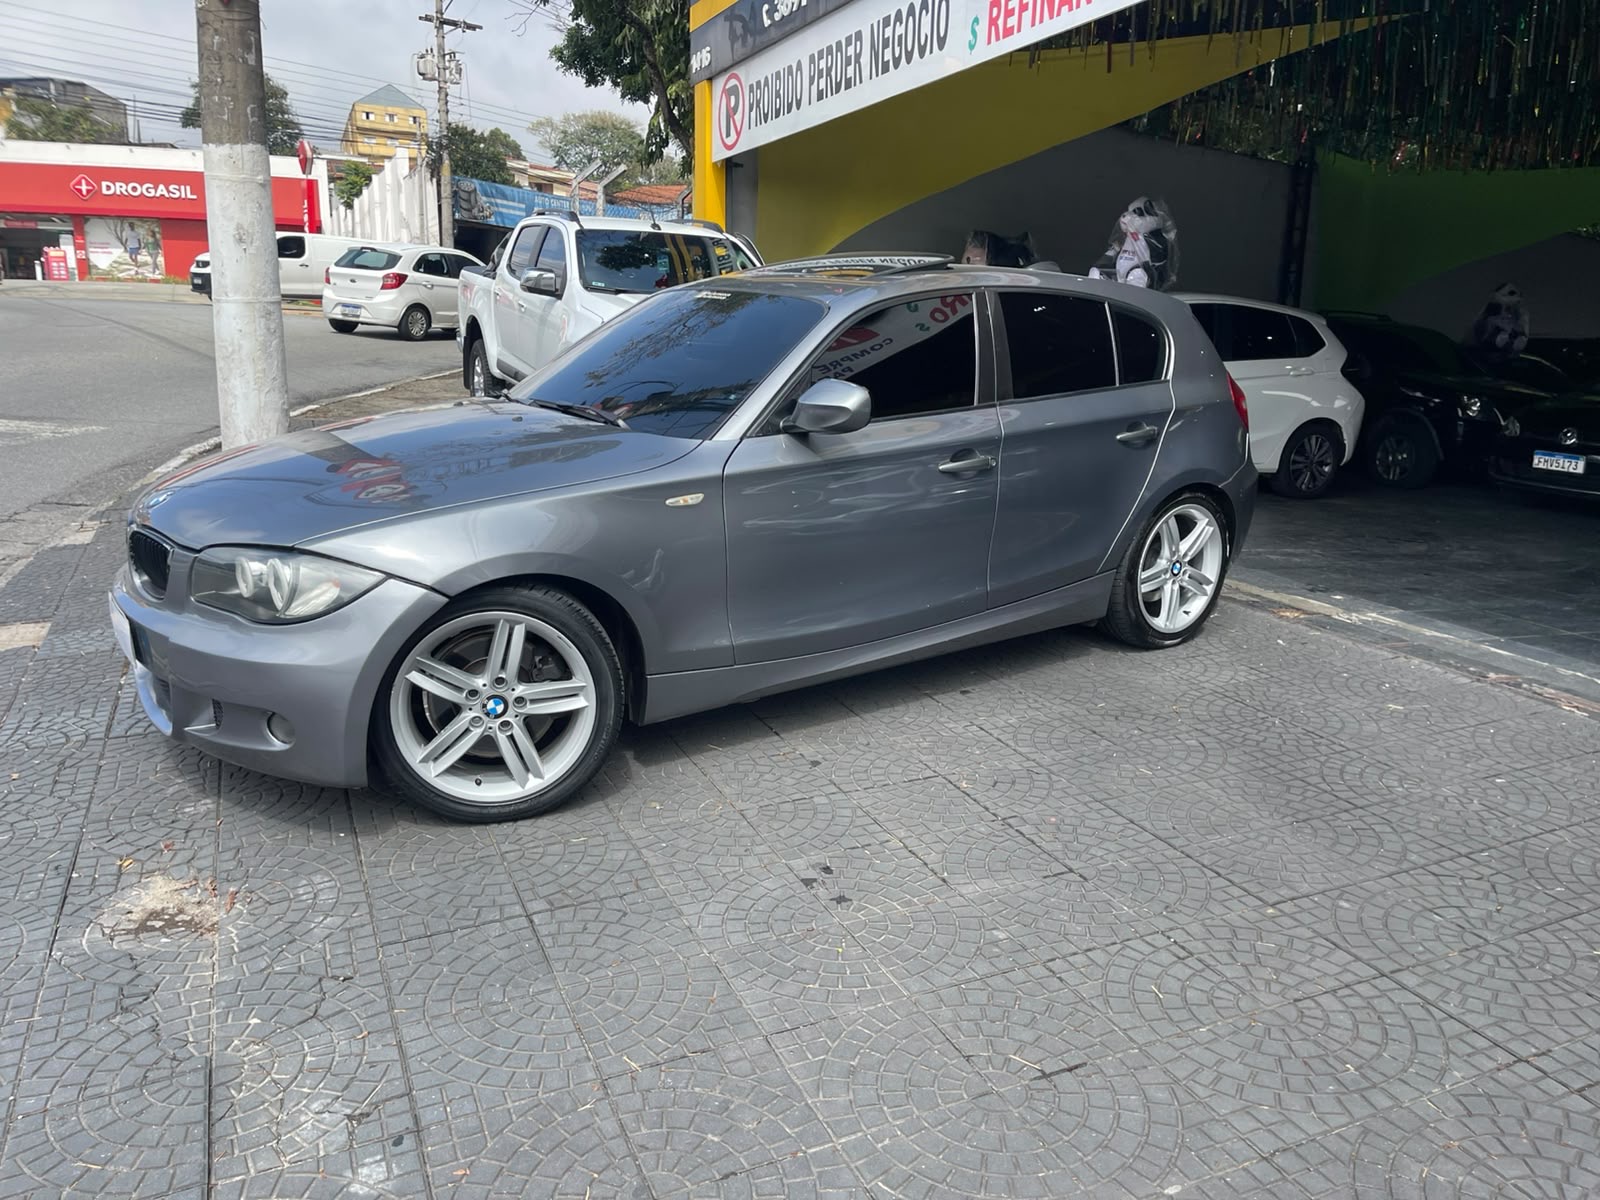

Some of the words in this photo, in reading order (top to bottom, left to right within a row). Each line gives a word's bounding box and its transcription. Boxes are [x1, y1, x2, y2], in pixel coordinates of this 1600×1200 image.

[748, 59, 803, 130] PROIBIDO
[808, 29, 863, 106] PERDER
[869, 0, 949, 81] NEGOCIO
[101, 181, 198, 199] DROGASIL
